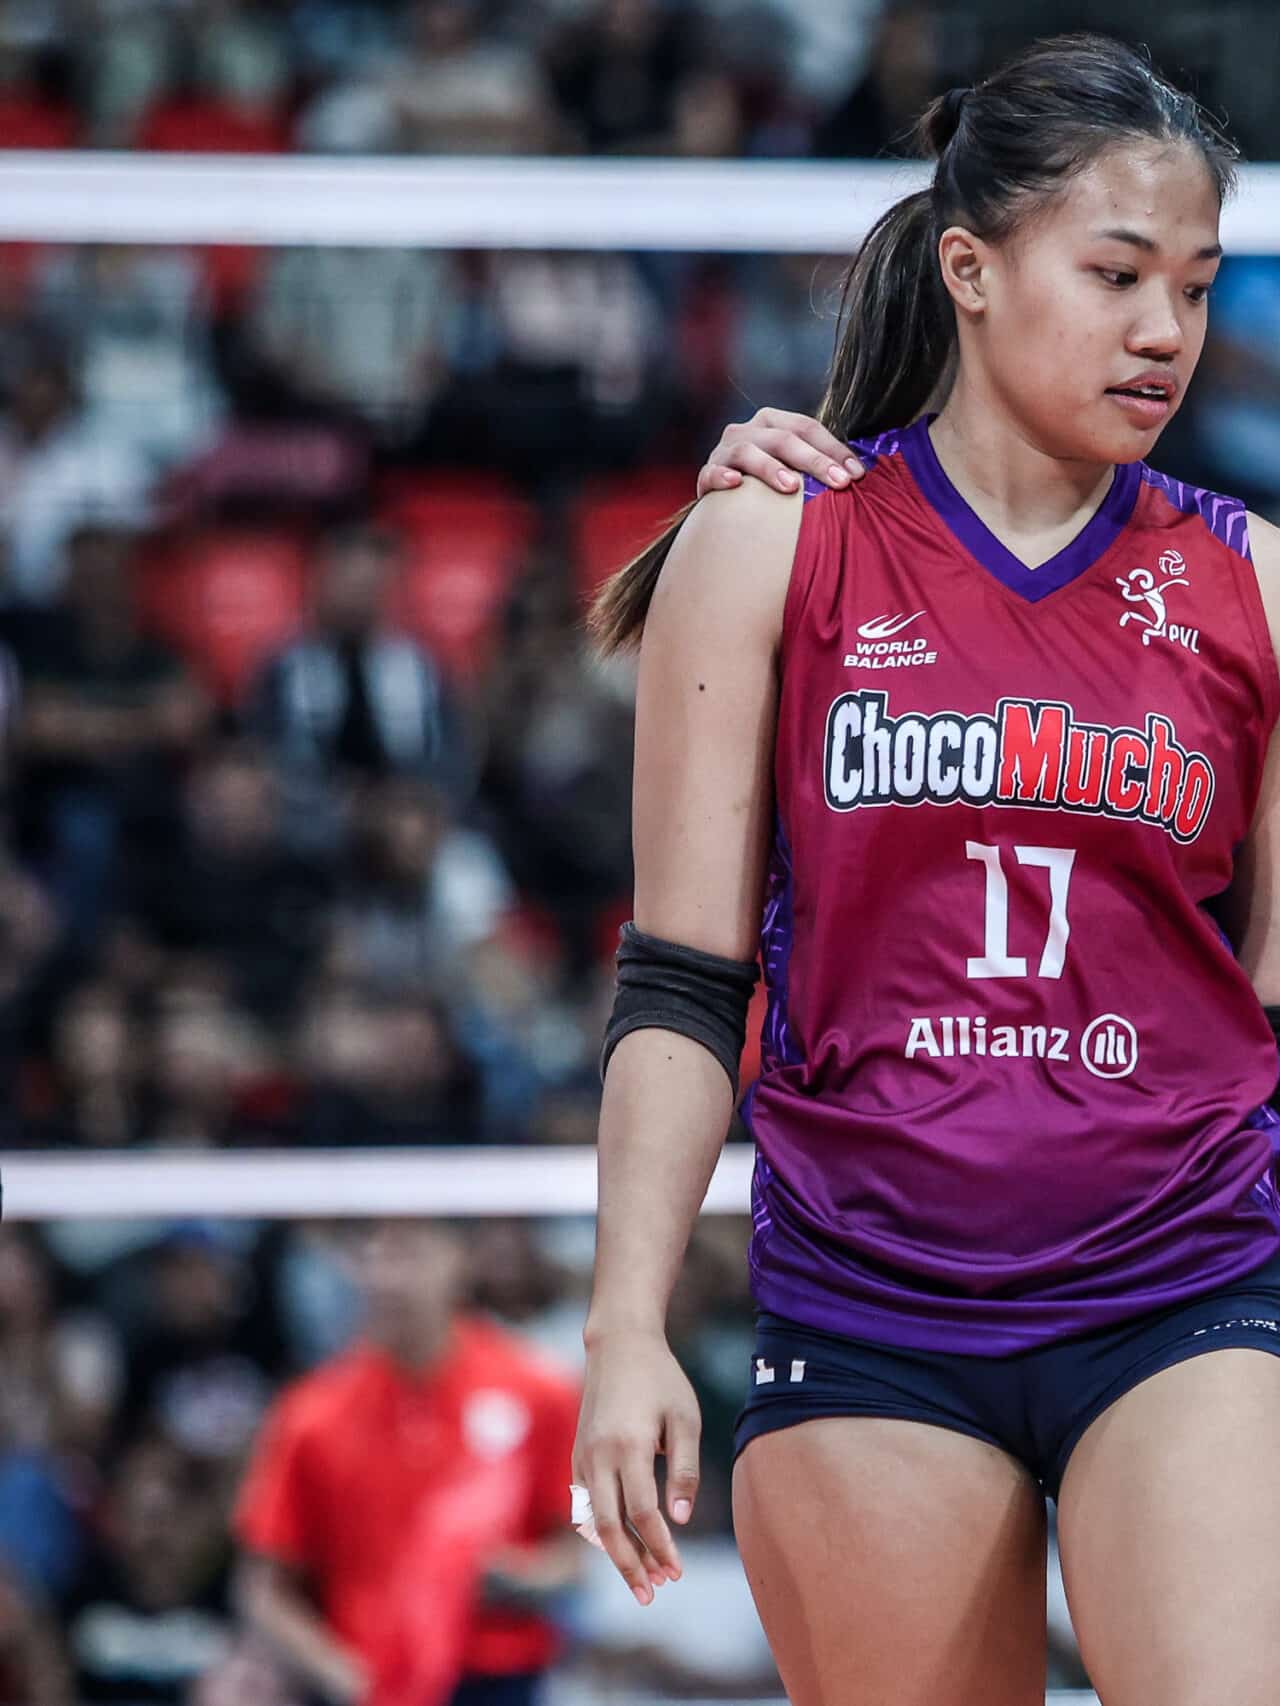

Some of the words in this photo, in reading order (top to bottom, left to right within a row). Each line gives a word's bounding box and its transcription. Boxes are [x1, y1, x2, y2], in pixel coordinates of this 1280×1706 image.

[856, 639, 927, 655] WORLD
[1168, 624, 1200, 655] PVL
[843, 652, 938, 669] BALANCE
[826, 695, 1212, 840] ChocoMucho
[965, 840, 1076, 979] 17
[905, 1017, 1070, 1061] Allianz
